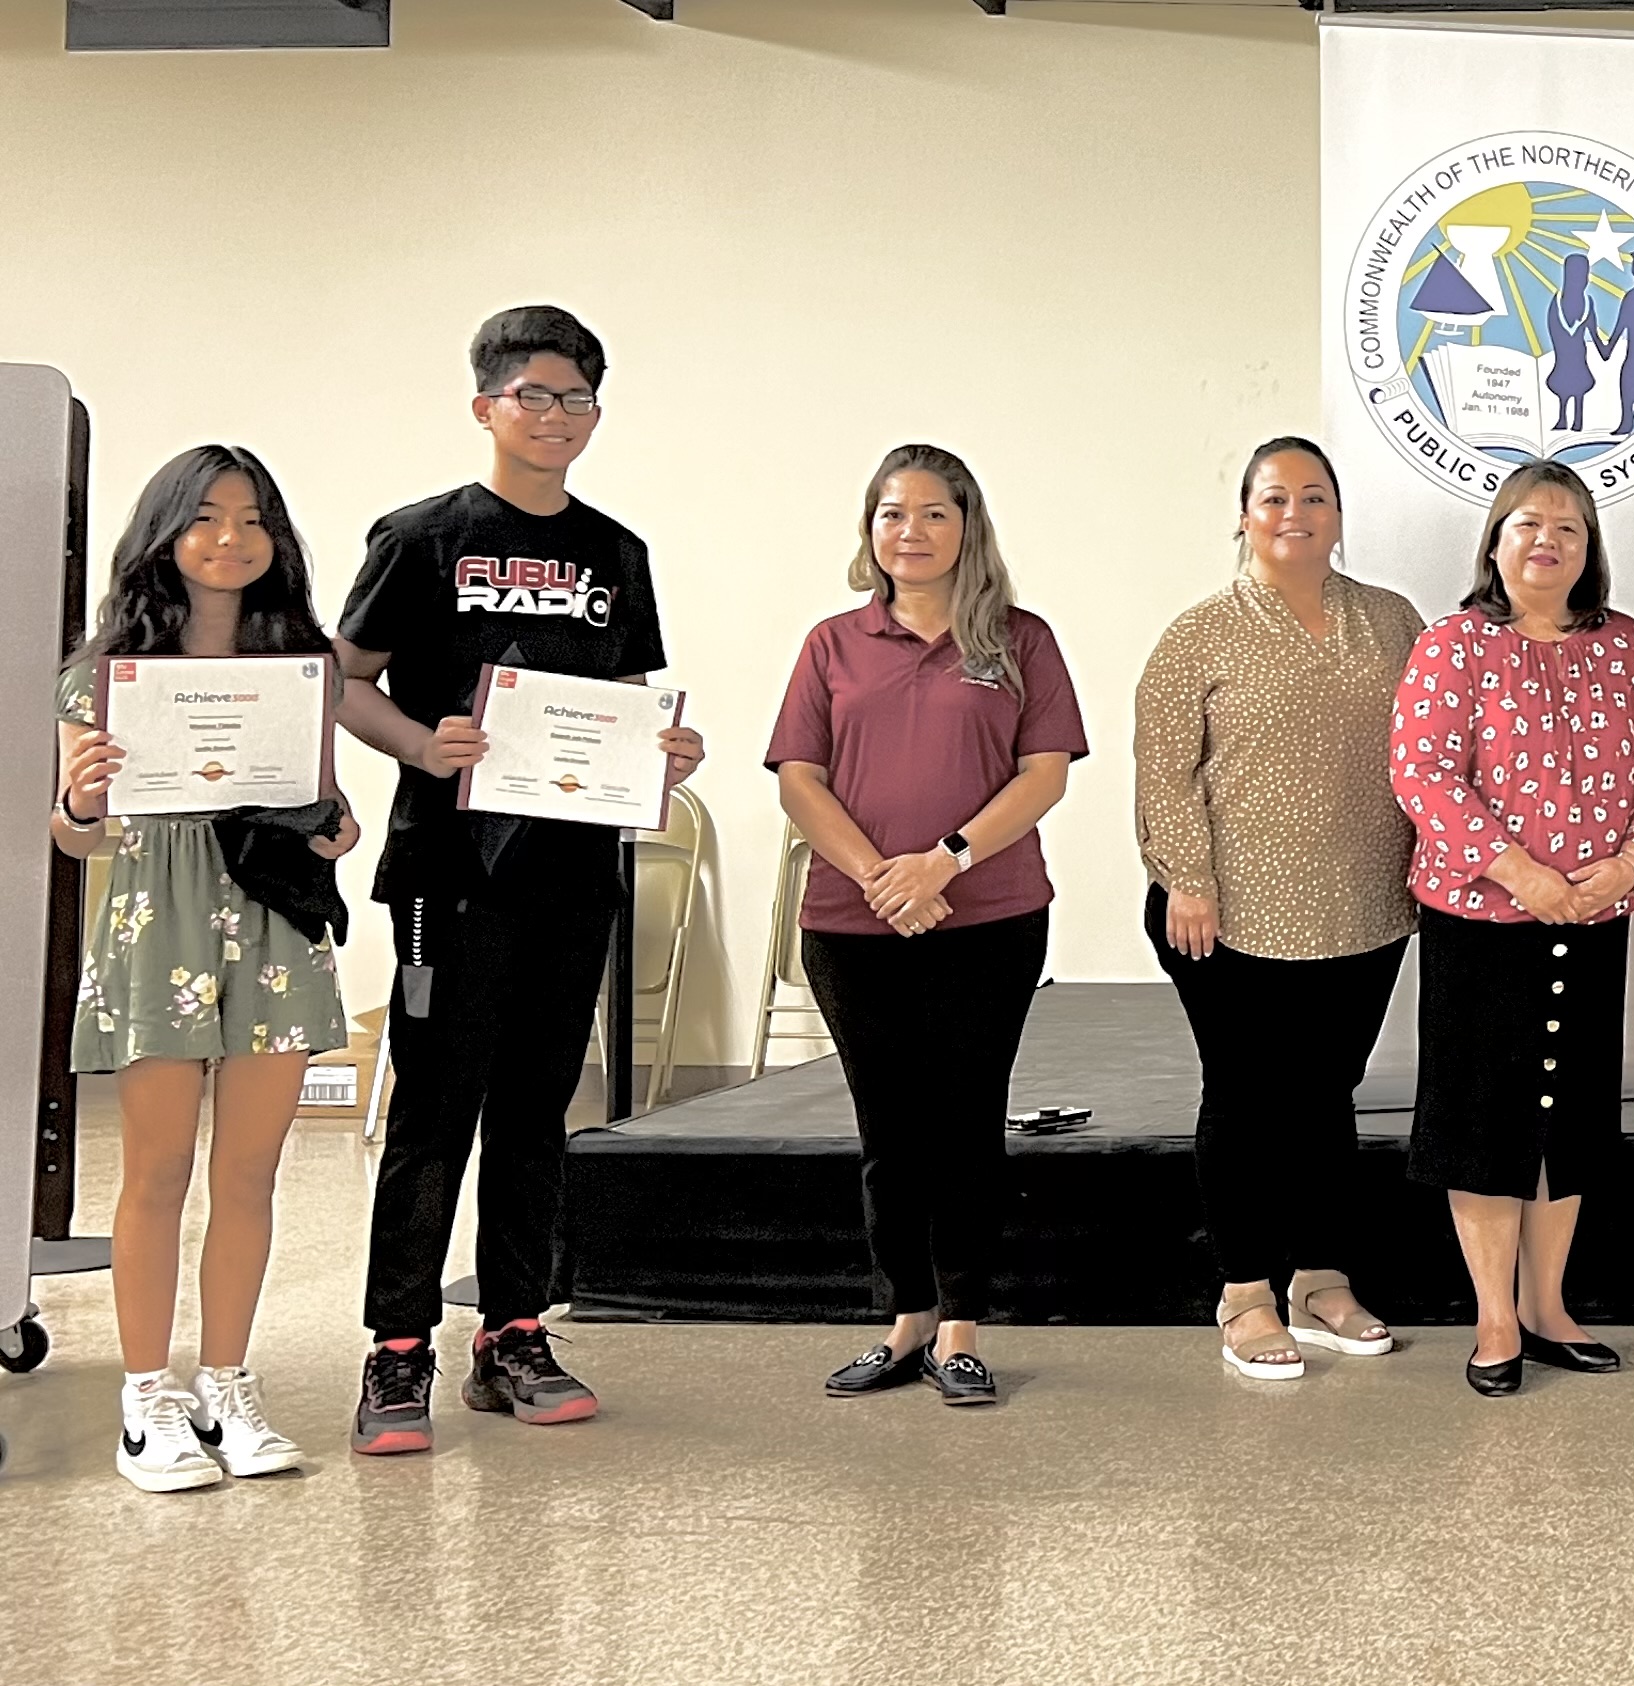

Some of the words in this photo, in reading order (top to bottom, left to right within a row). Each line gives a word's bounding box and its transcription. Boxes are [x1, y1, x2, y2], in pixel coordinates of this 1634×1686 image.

[1359, 183, 1437, 370] COMMONWEALTH
[1435, 161, 1463, 190] OF
[1467, 146, 1515, 174] THE
[1477, 364, 1521, 376] Founded
[1471, 390, 1522, 404] Autonomy
[1393, 409, 1477, 482] PUBLIC
[455, 556, 576, 592] FUBU
[456, 570, 613, 627] RADIO
